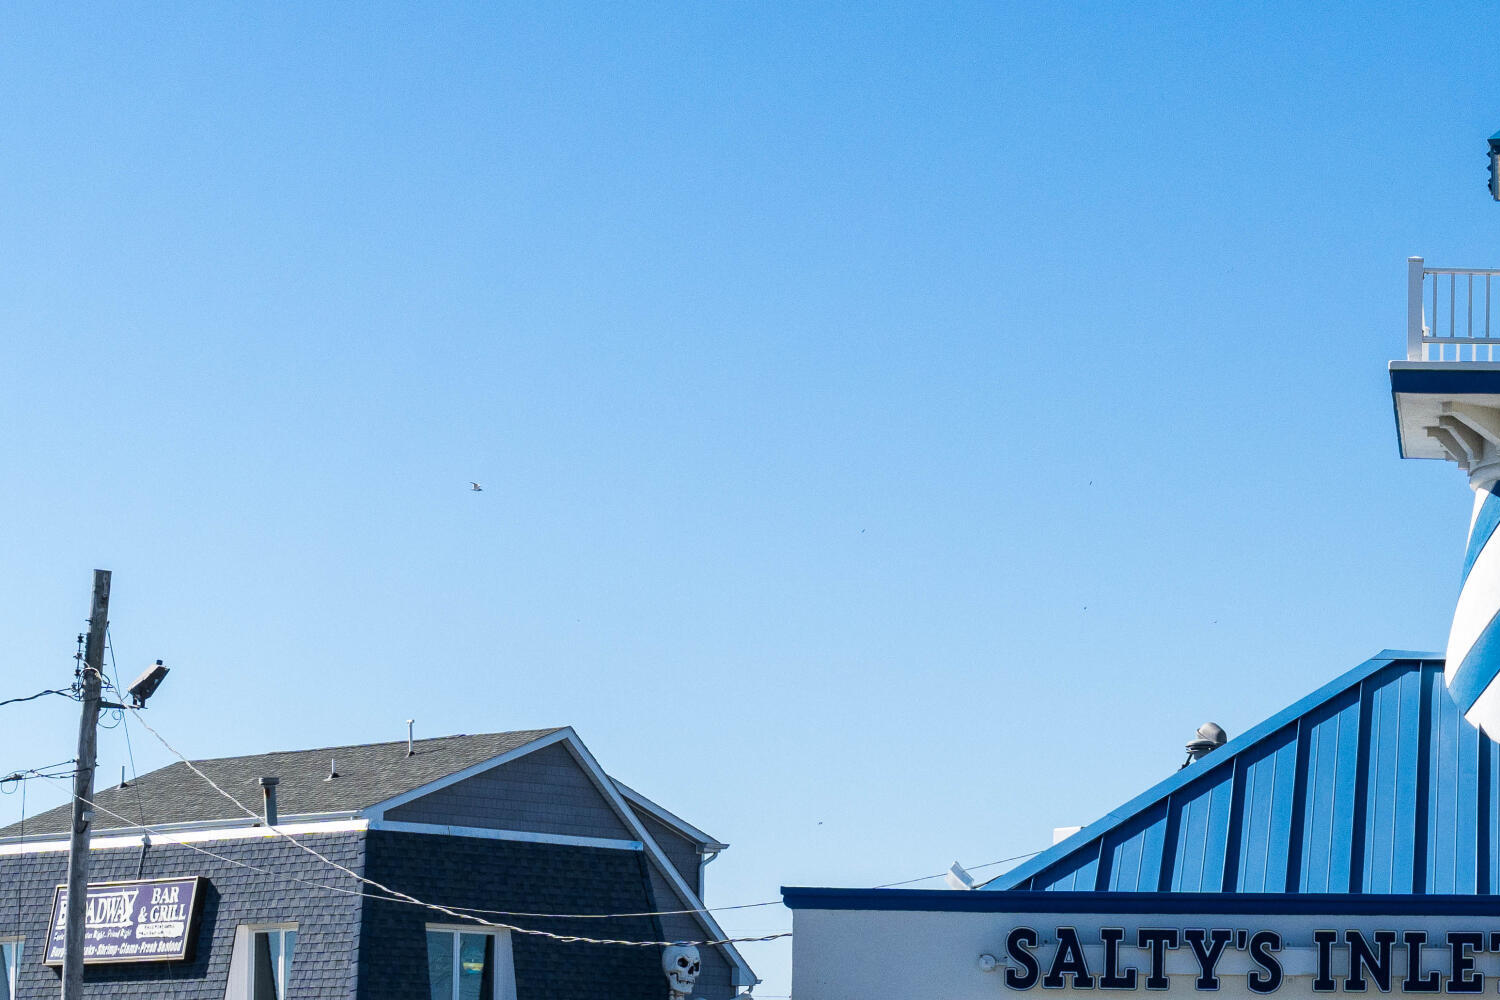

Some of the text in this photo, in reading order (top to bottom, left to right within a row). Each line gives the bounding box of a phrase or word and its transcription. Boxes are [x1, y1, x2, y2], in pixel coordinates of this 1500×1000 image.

[57, 891, 138, 926] BADWAY
[151, 887, 179, 904] BAR
[138, 904, 186, 922] & GRILL
[1005, 926, 1283, 993] SALTY'S
